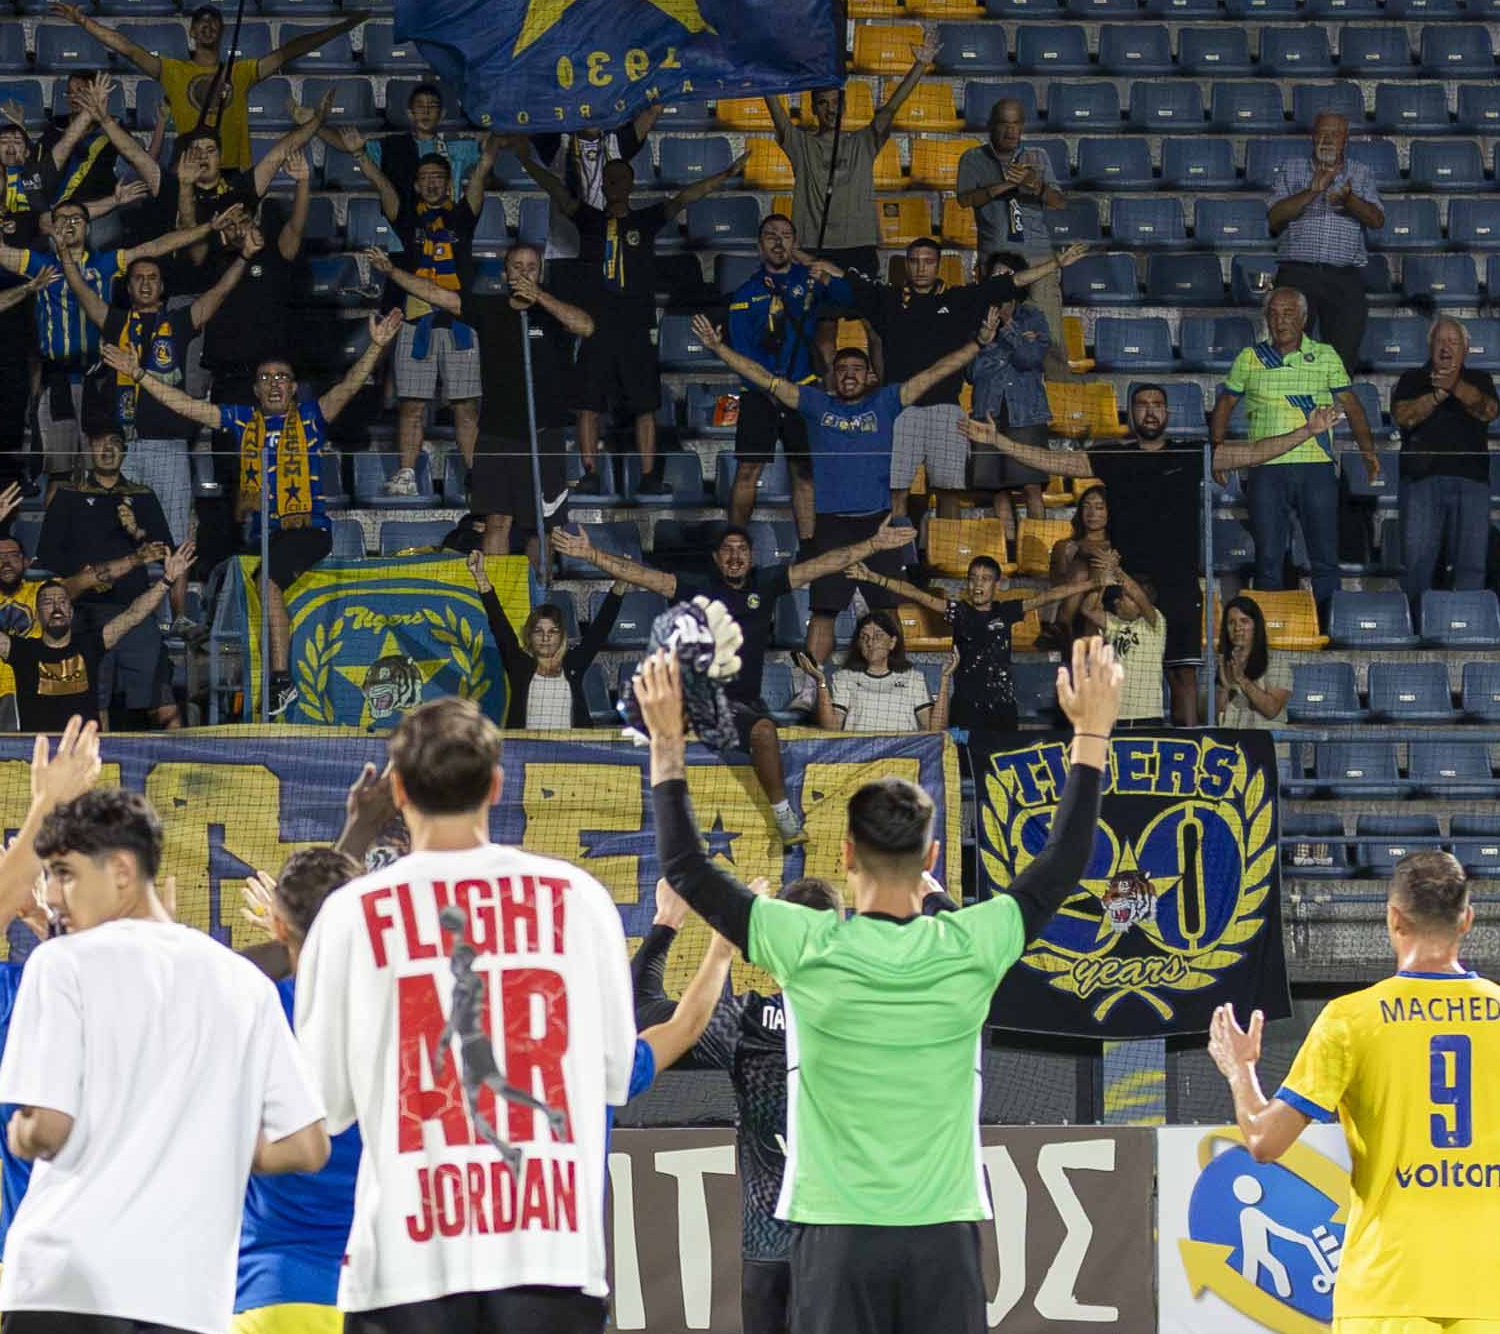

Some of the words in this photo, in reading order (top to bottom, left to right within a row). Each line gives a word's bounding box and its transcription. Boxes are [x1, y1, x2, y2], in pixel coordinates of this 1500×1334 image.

[343, 605, 425, 635] Tigers
[989, 735, 1249, 801] TIERS
[361, 875, 573, 968] FLIGHT
[1071, 953, 1191, 999] years
[398, 967, 574, 1154] AIR
[1429, 1034, 1472, 1149] 9
[405, 1160, 580, 1244] JORDAN
